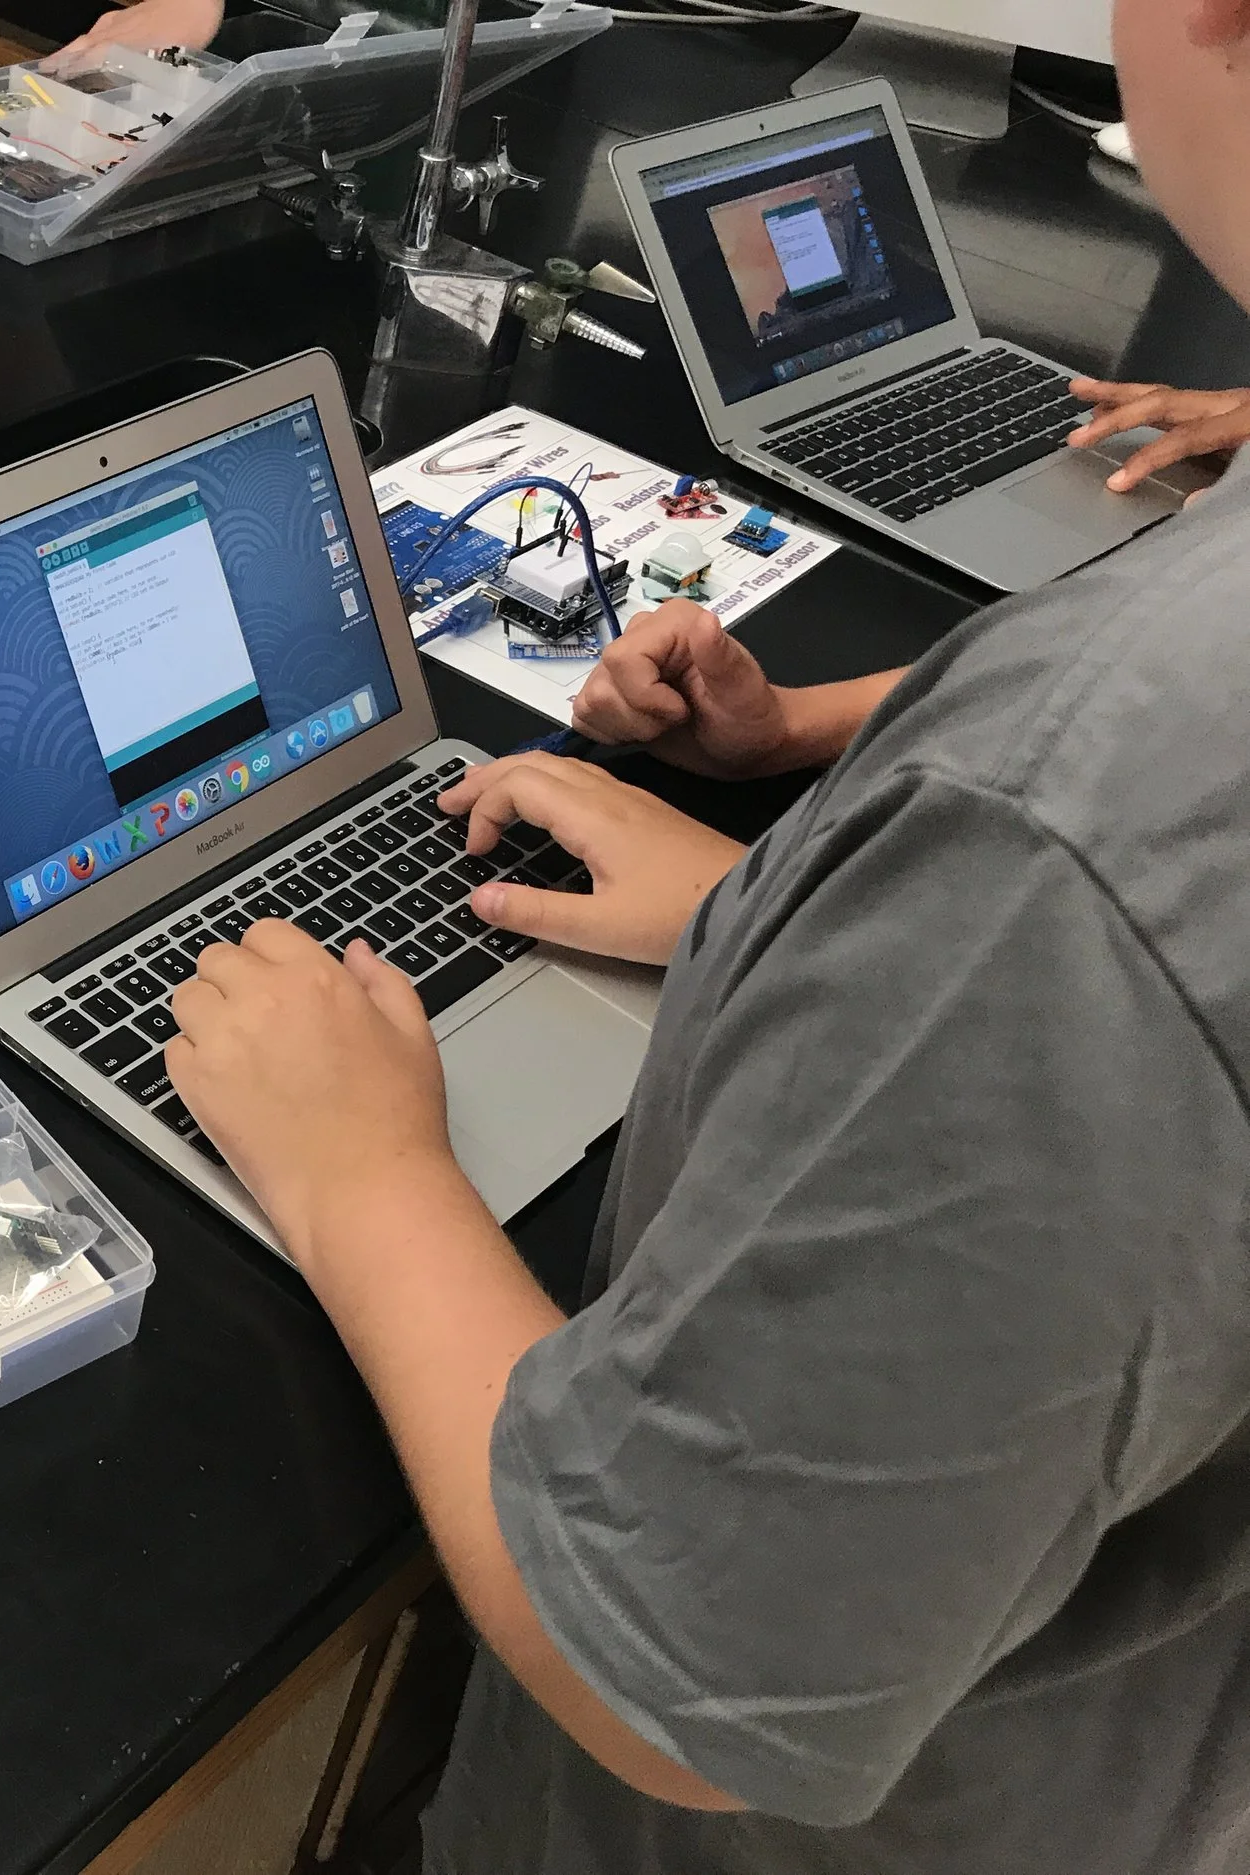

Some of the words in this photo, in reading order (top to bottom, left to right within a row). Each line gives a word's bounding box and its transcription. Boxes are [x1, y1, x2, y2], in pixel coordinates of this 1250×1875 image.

[534, 445, 569, 476] Wires
[613, 477, 673, 512] Resistors
[622, 519, 662, 550] Sensor
[711, 588, 749, 616] ensor
[739, 567, 786, 594] Temp.
[776, 540, 820, 570] Sensor
[196, 830, 235, 856] MacBook
[234, 821, 246, 838] Air
[104, 1057, 118, 1068] tab
[140, 1082, 158, 1098] caps
